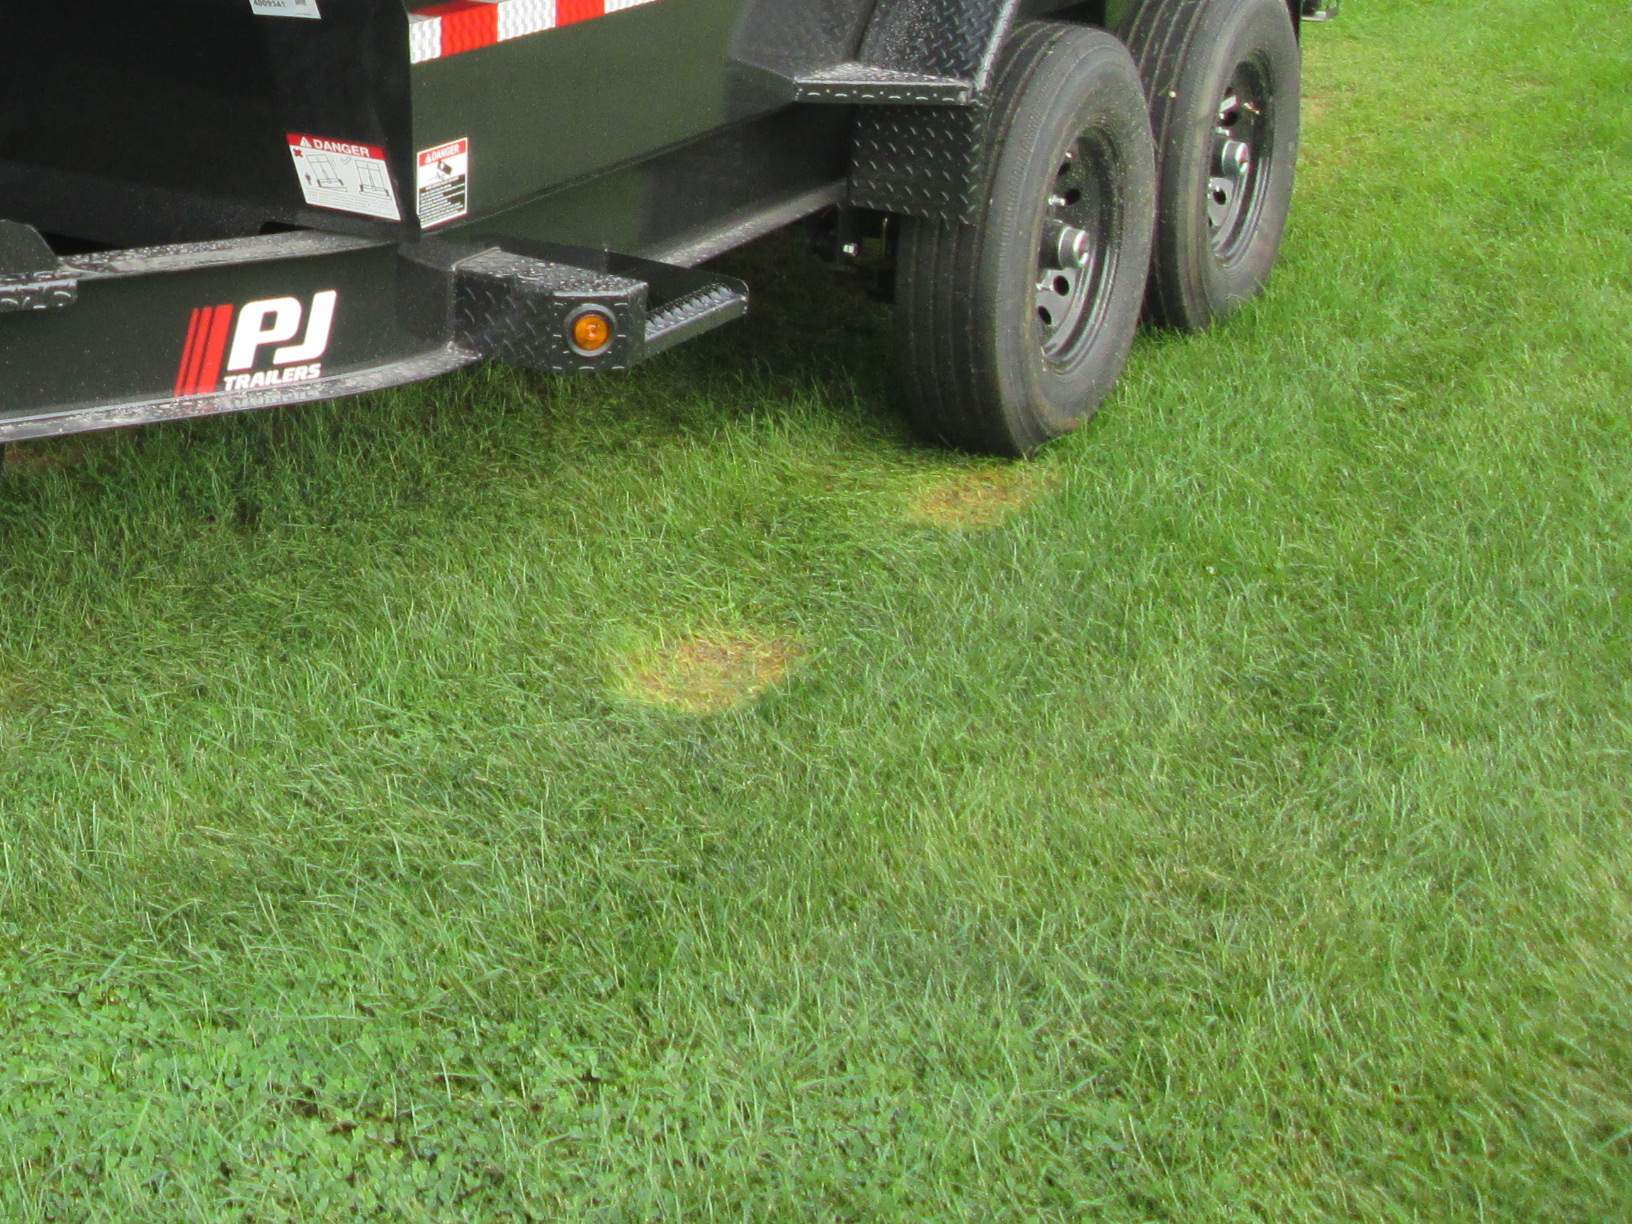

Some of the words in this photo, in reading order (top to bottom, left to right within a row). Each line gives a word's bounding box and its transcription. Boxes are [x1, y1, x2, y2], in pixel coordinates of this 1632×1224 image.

[312, 139, 370, 157] DANGER
[431, 144, 460, 162] DANGER
[227, 290, 337, 371] PJ
[223, 363, 321, 392] TRAILERS
